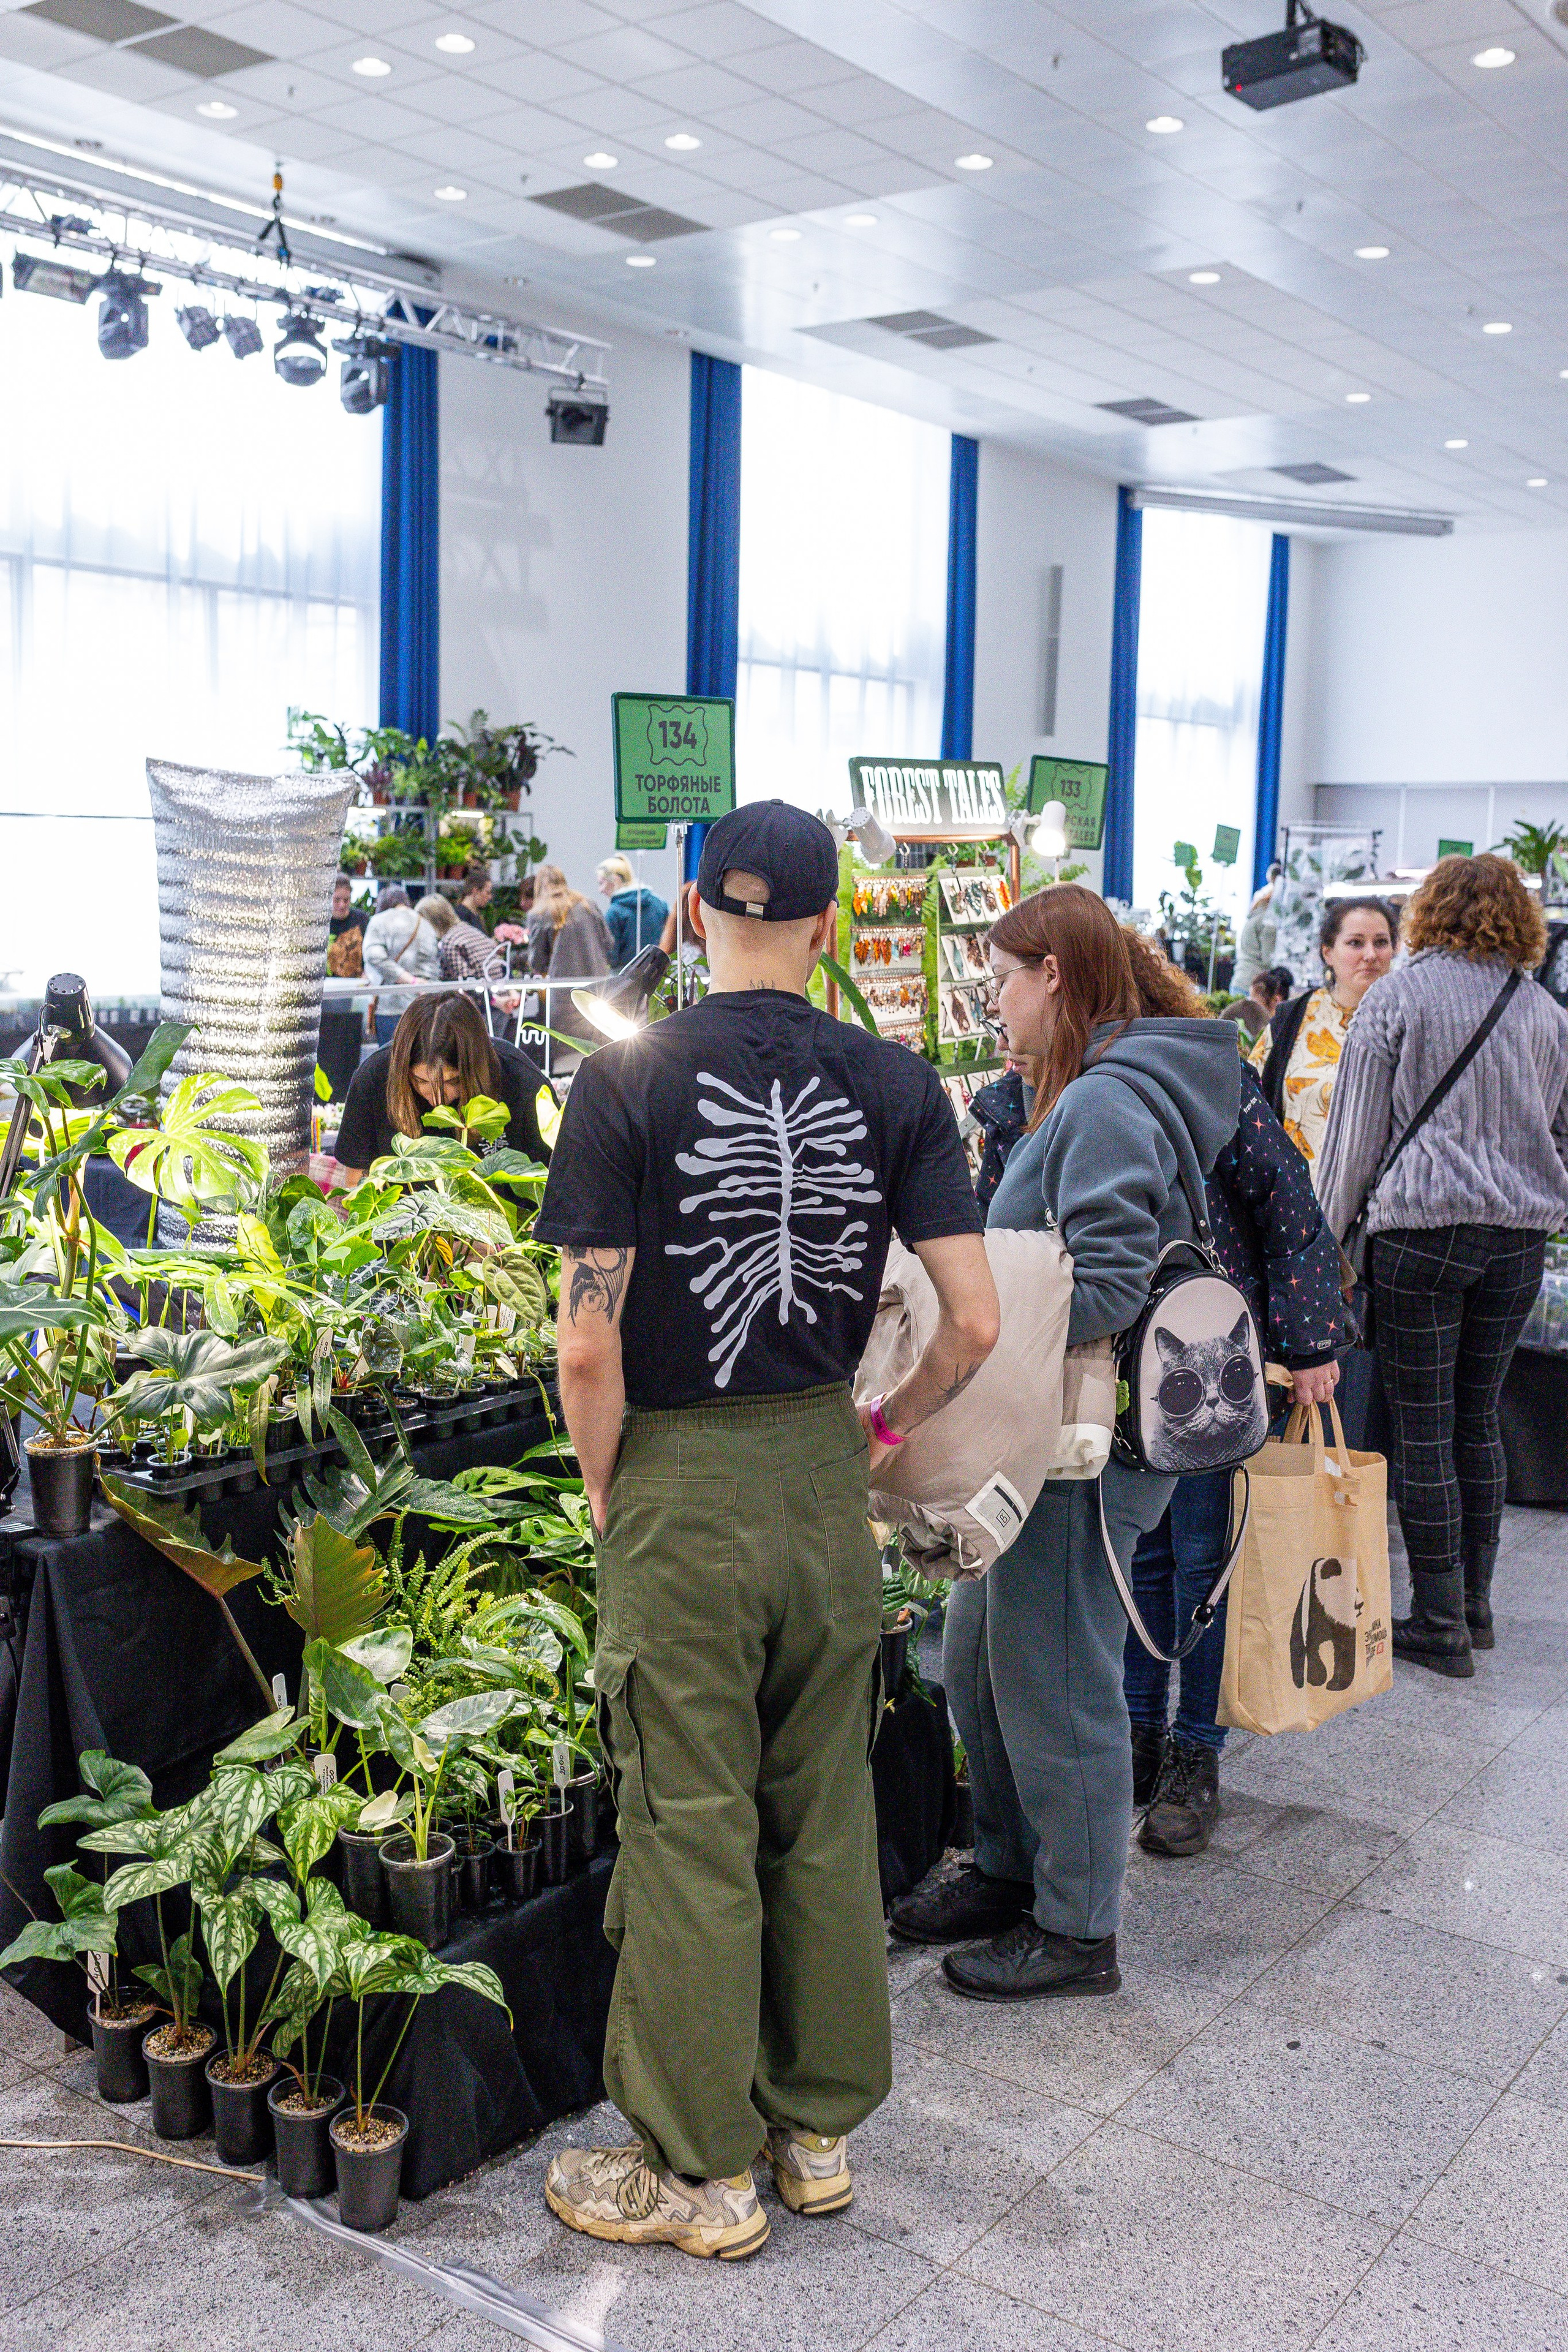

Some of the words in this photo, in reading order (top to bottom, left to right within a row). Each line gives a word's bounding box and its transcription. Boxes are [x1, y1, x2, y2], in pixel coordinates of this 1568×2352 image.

[658, 720, 697, 749] 134
[635, 774, 722, 793] ТОРФЯНЫЕ
[1060, 779, 1081, 798] 133
[648, 796, 710, 814] БОЛОТА
[859, 766, 943, 825] FOREST
[942, 769, 1006, 825] TALES
